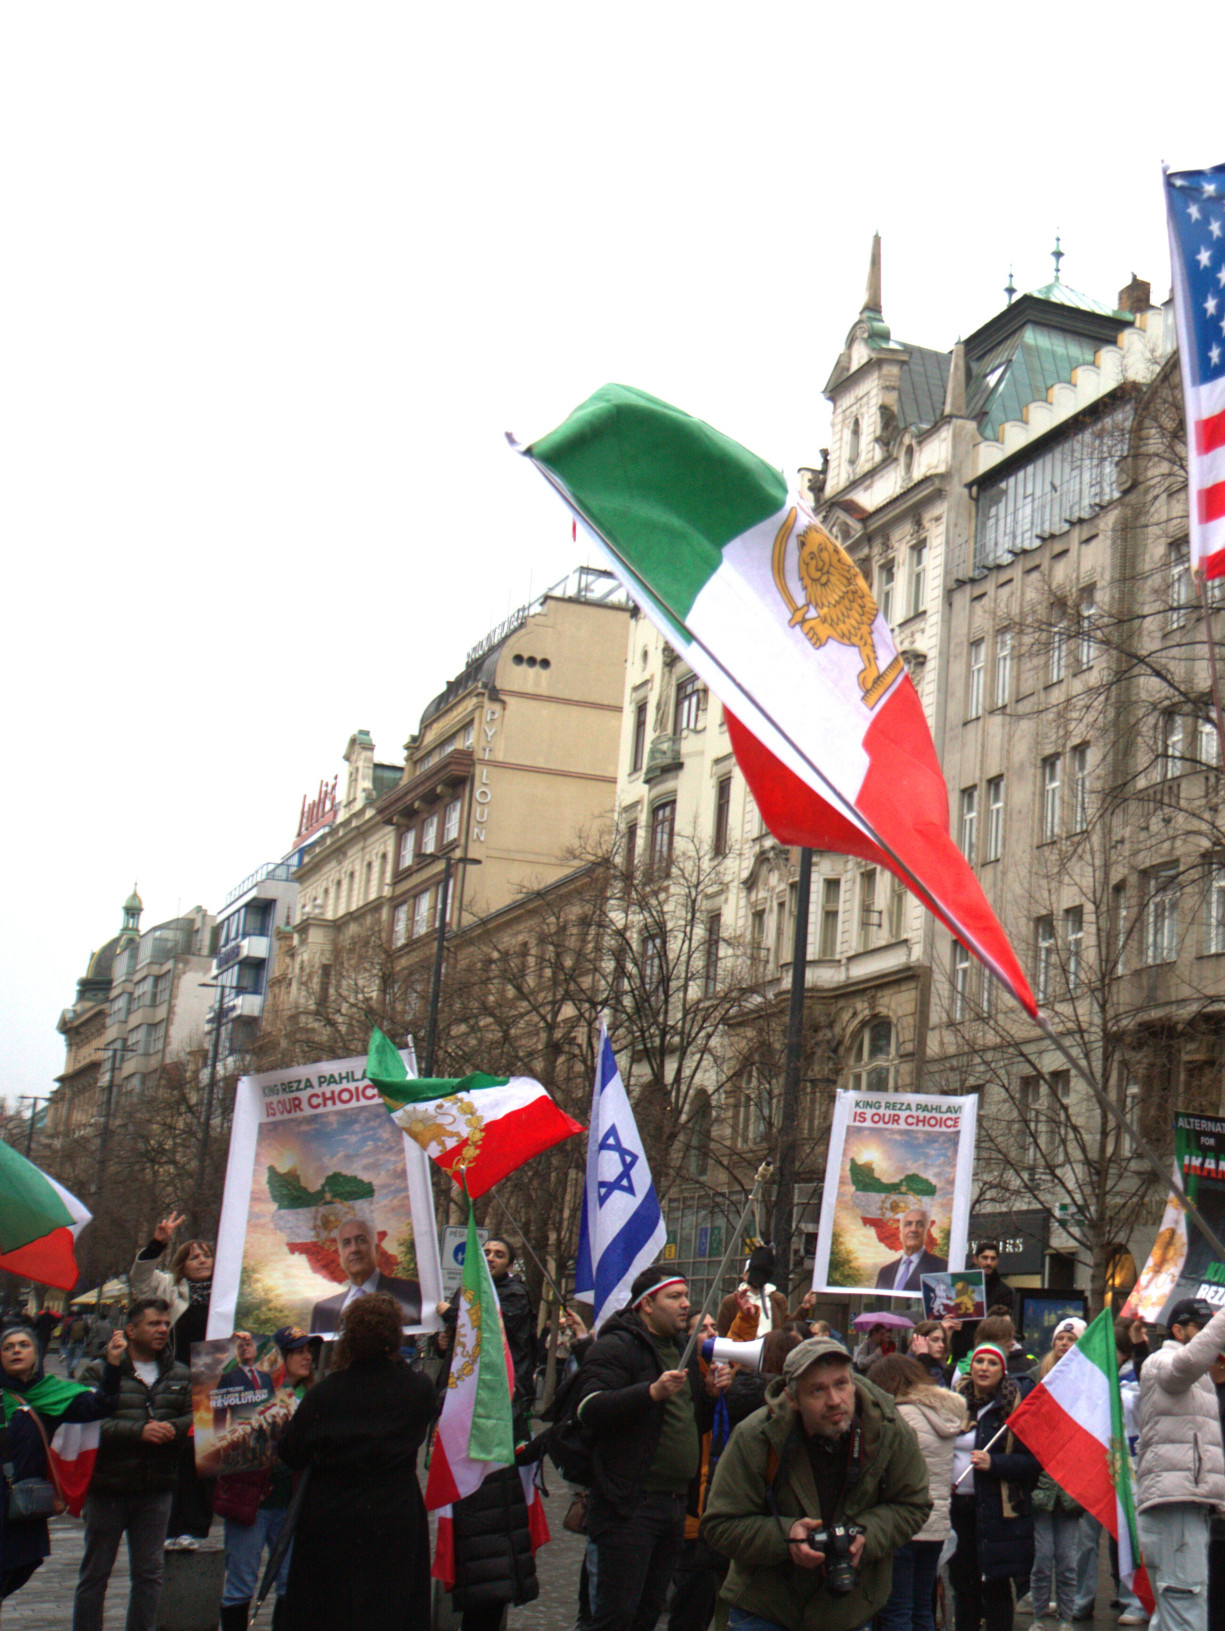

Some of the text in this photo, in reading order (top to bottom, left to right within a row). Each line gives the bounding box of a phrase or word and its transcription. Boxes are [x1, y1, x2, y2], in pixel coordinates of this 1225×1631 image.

[473, 708, 499, 842] PYTLOUN
[261, 1084, 280, 1098] KING
[281, 1077, 315, 1094] REZA
[265, 1084, 383, 1118] IS OUR CHOIC
[854, 1099, 962, 1114] KING REZA PAHLAVI
[853, 1111, 960, 1129] IS OUR CHOICE
[1200, 1136, 1215, 1146] FOR
[210, 1394, 268, 1408] REVOLUTION
